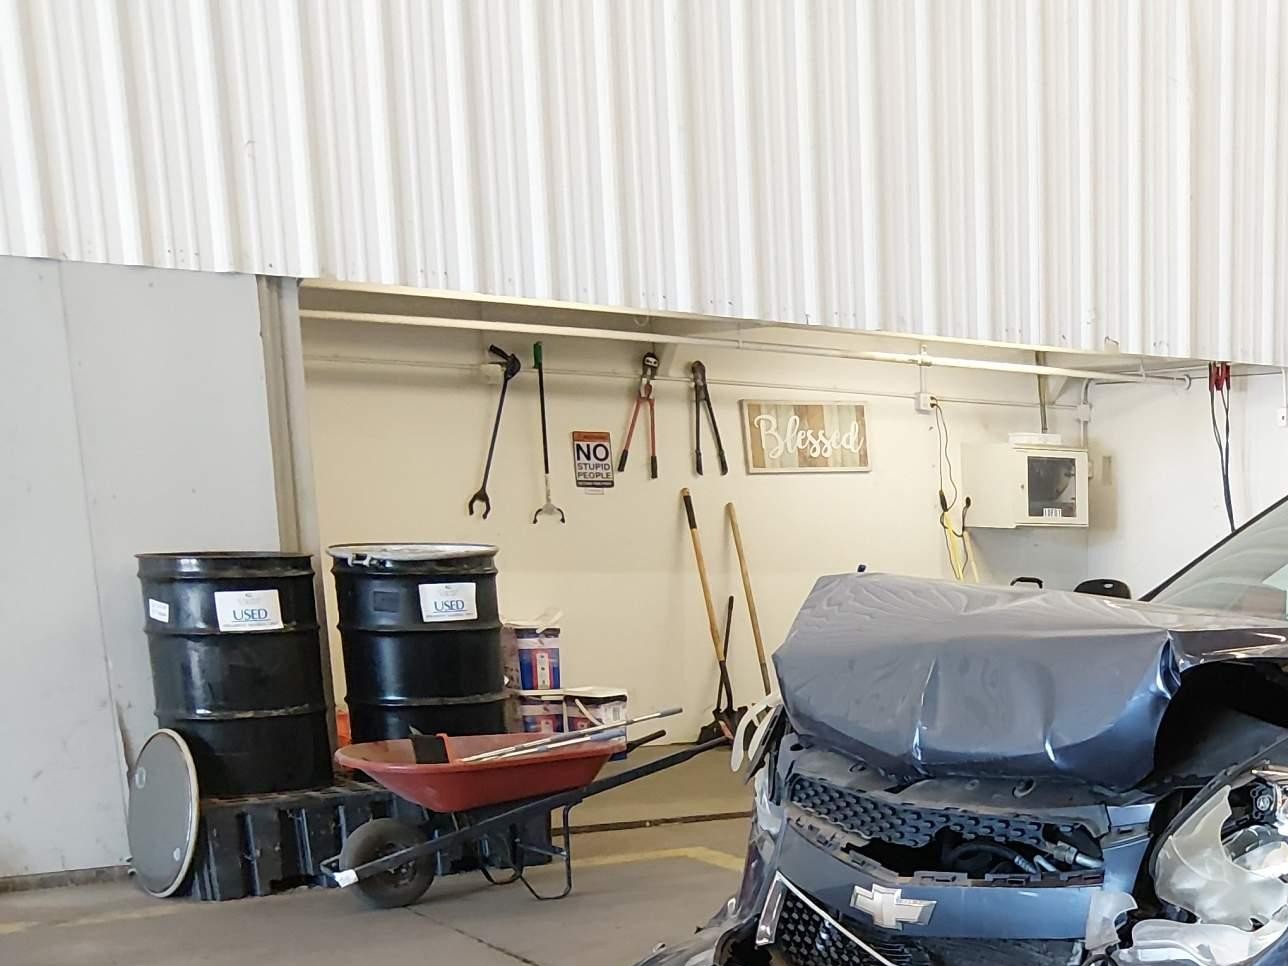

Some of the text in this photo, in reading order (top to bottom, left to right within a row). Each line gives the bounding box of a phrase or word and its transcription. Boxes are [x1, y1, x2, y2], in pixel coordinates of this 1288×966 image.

[754, 414, 864, 458] Blessed
[575, 443, 610, 462] NO
[577, 462, 611, 471] STUPID
[577, 471, 612, 480] PEOPLE
[432, 599, 465, 612] USED
[232, 608, 268, 621] USED
